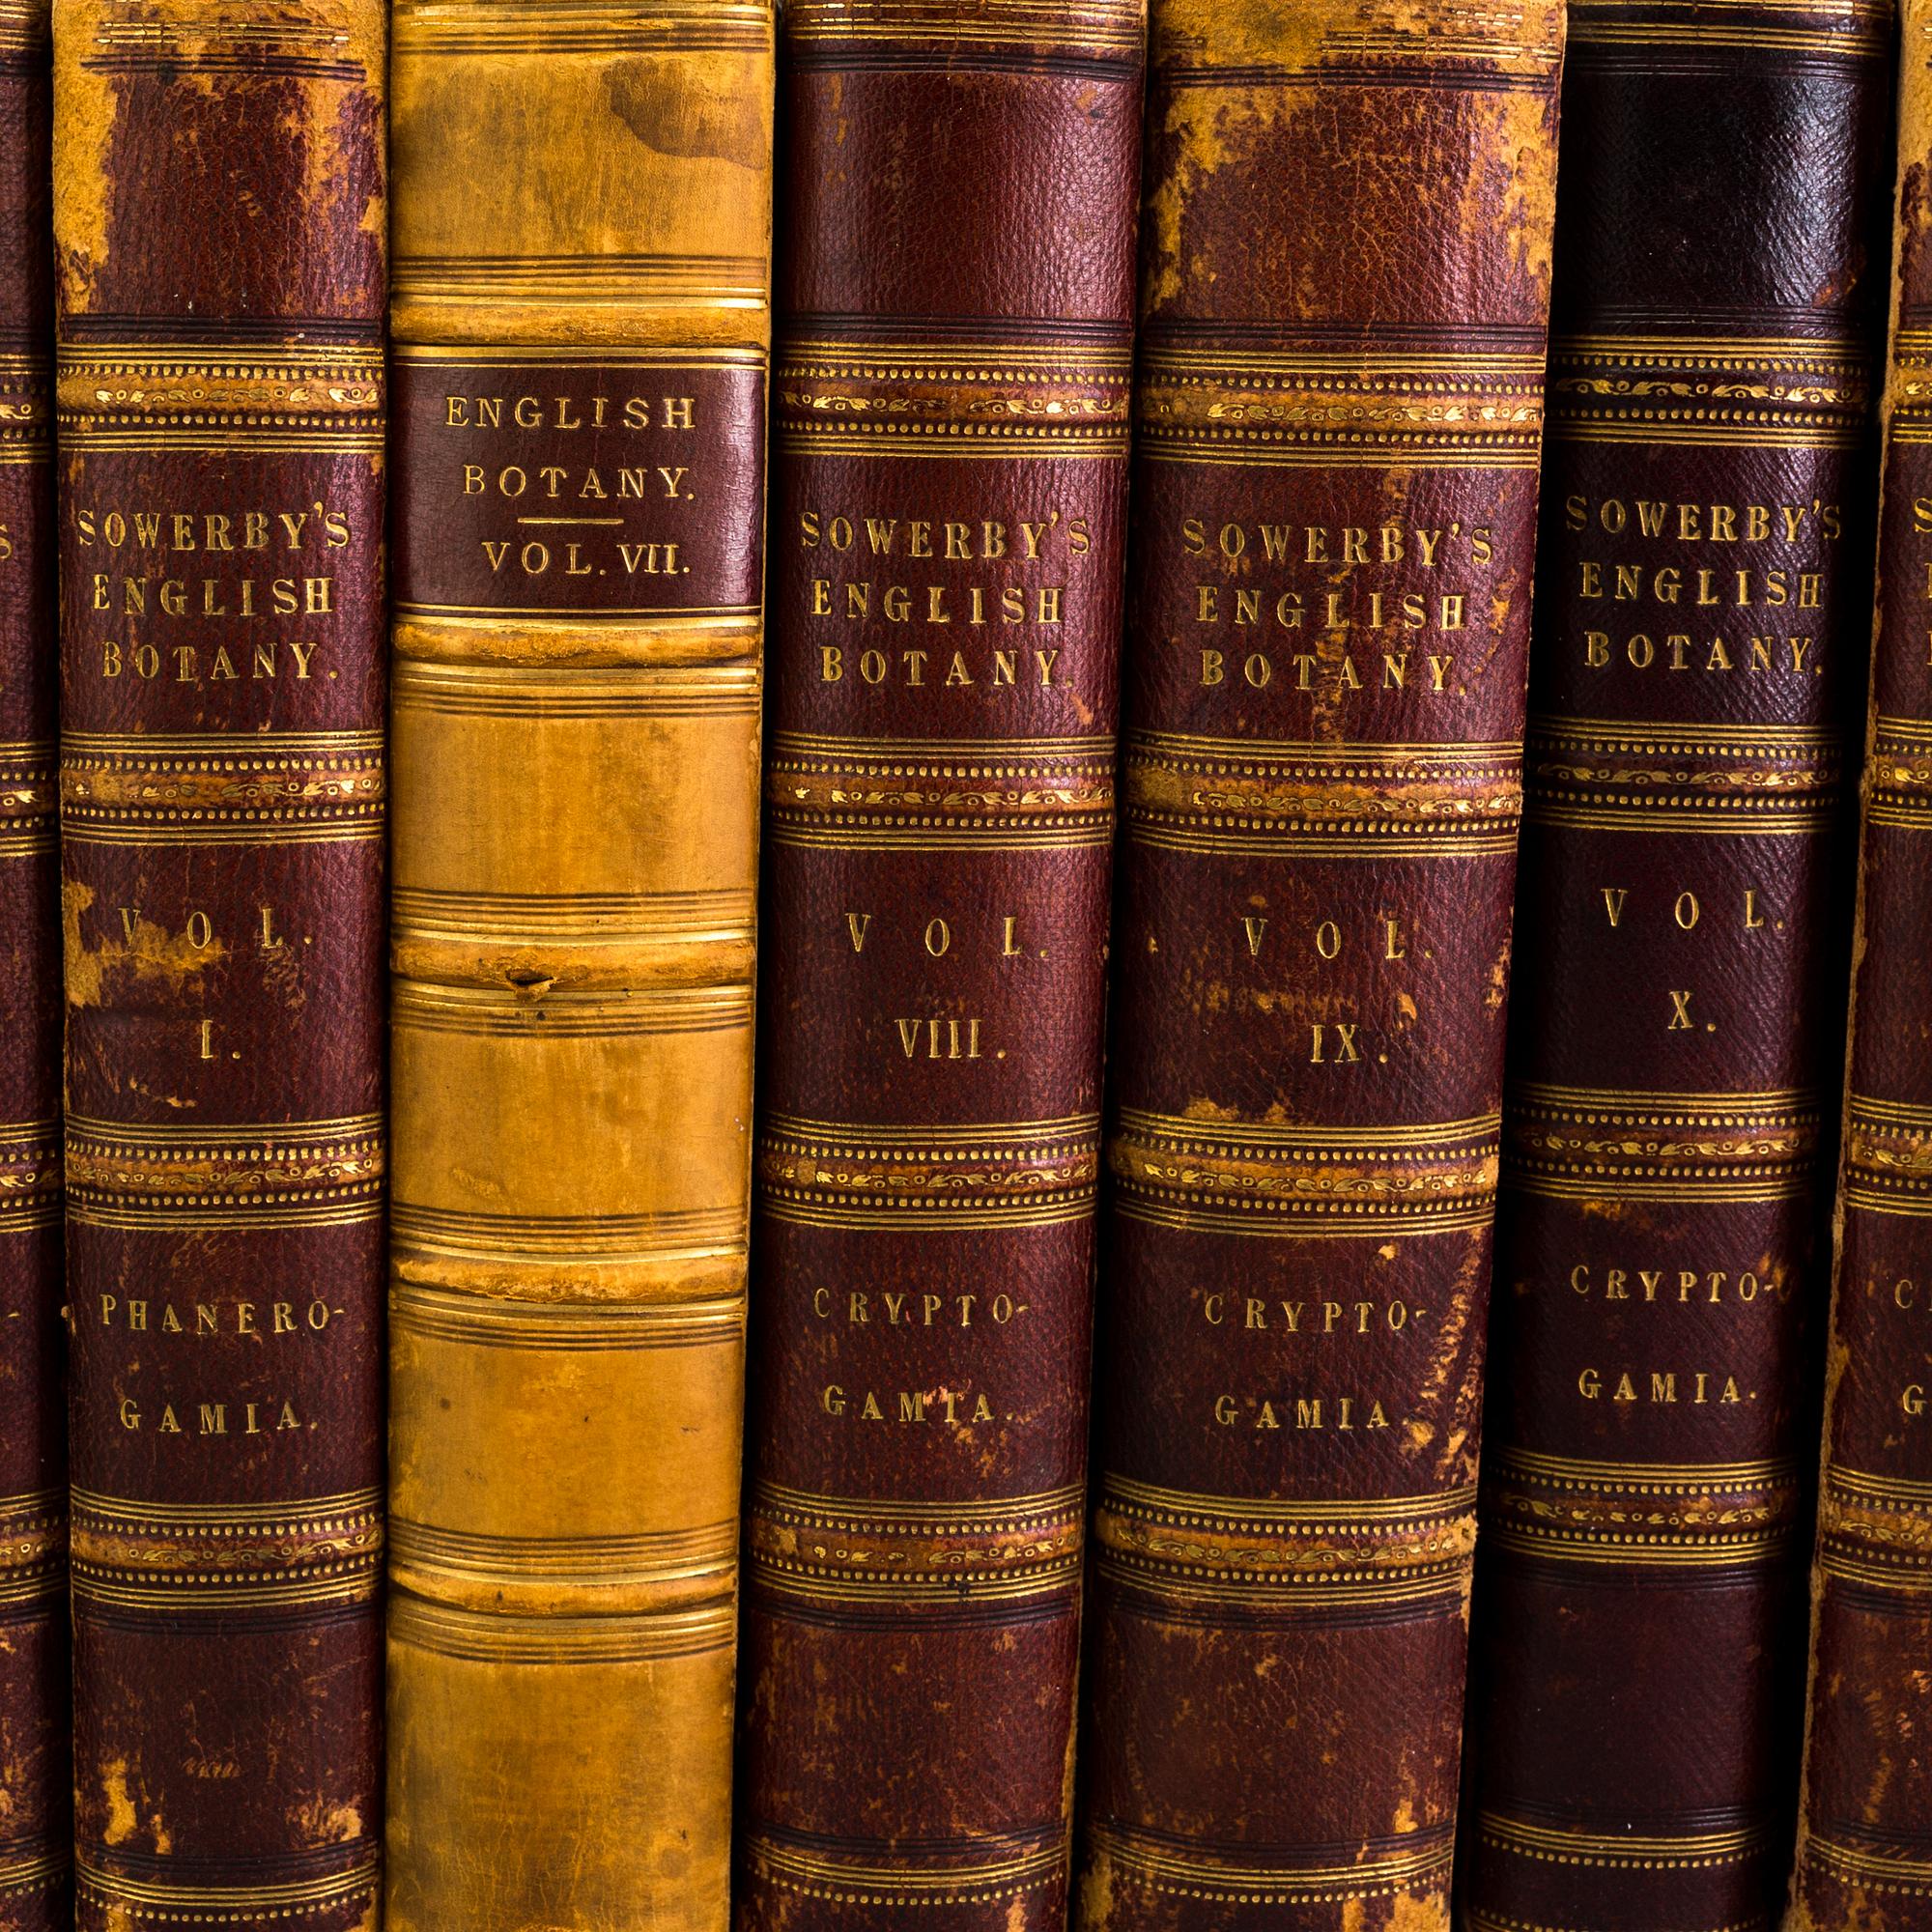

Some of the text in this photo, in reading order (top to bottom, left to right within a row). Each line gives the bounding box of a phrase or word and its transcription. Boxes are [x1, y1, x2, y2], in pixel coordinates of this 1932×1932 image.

[445, 395, 696, 430] ENGLISH
[462, 466, 694, 500] BOTANY.
[77, 503, 351, 553] SOWERBY'S
[800, 512, 1091, 560] SOWERBY'S
[1566, 495, 1841, 542] SOWERBY'S
[481, 541, 691, 577] VOL. VII.
[1182, 518, 1492, 566] SOWERBY'S
[92, 574, 333, 617] ENGLISH
[811, 579, 1063, 626] ENGLISH
[1579, 561, 1824, 609] ENGLISH
[1198, 585, 1465, 631] ENGLISH
[102, 640, 338, 682] BOTANY.
[820, 645, 1073, 688] BOTANY.
[1199, 649, 1467, 696] BOTANY.
[1584, 631, 1824, 675] BOTANY.
[118, 907, 313, 950] VOL.
[1601, 888, 1784, 929] VOL.
[845, 912, 1049, 960] VOL.
[1241, 917, 1435, 960] VOL.
[1667, 990, 1717, 1033] X.
[200, 1019, 242, 1060] I.
[895, 1017, 1007, 1060] VIII.
[1310, 1024, 1390, 1065] IX.
[1571, 1264, 1776, 1304] CRYPTO-
[99, 1293, 345, 1335] PHANERO-
[813, 1289, 1030, 1327] CRYPTO-
[1206, 1294, 1427, 1333] CRYPTO-
[1578, 1368, 1757, 1404] GAMIA.
[120, 1399, 319, 1435] GAMIA.
